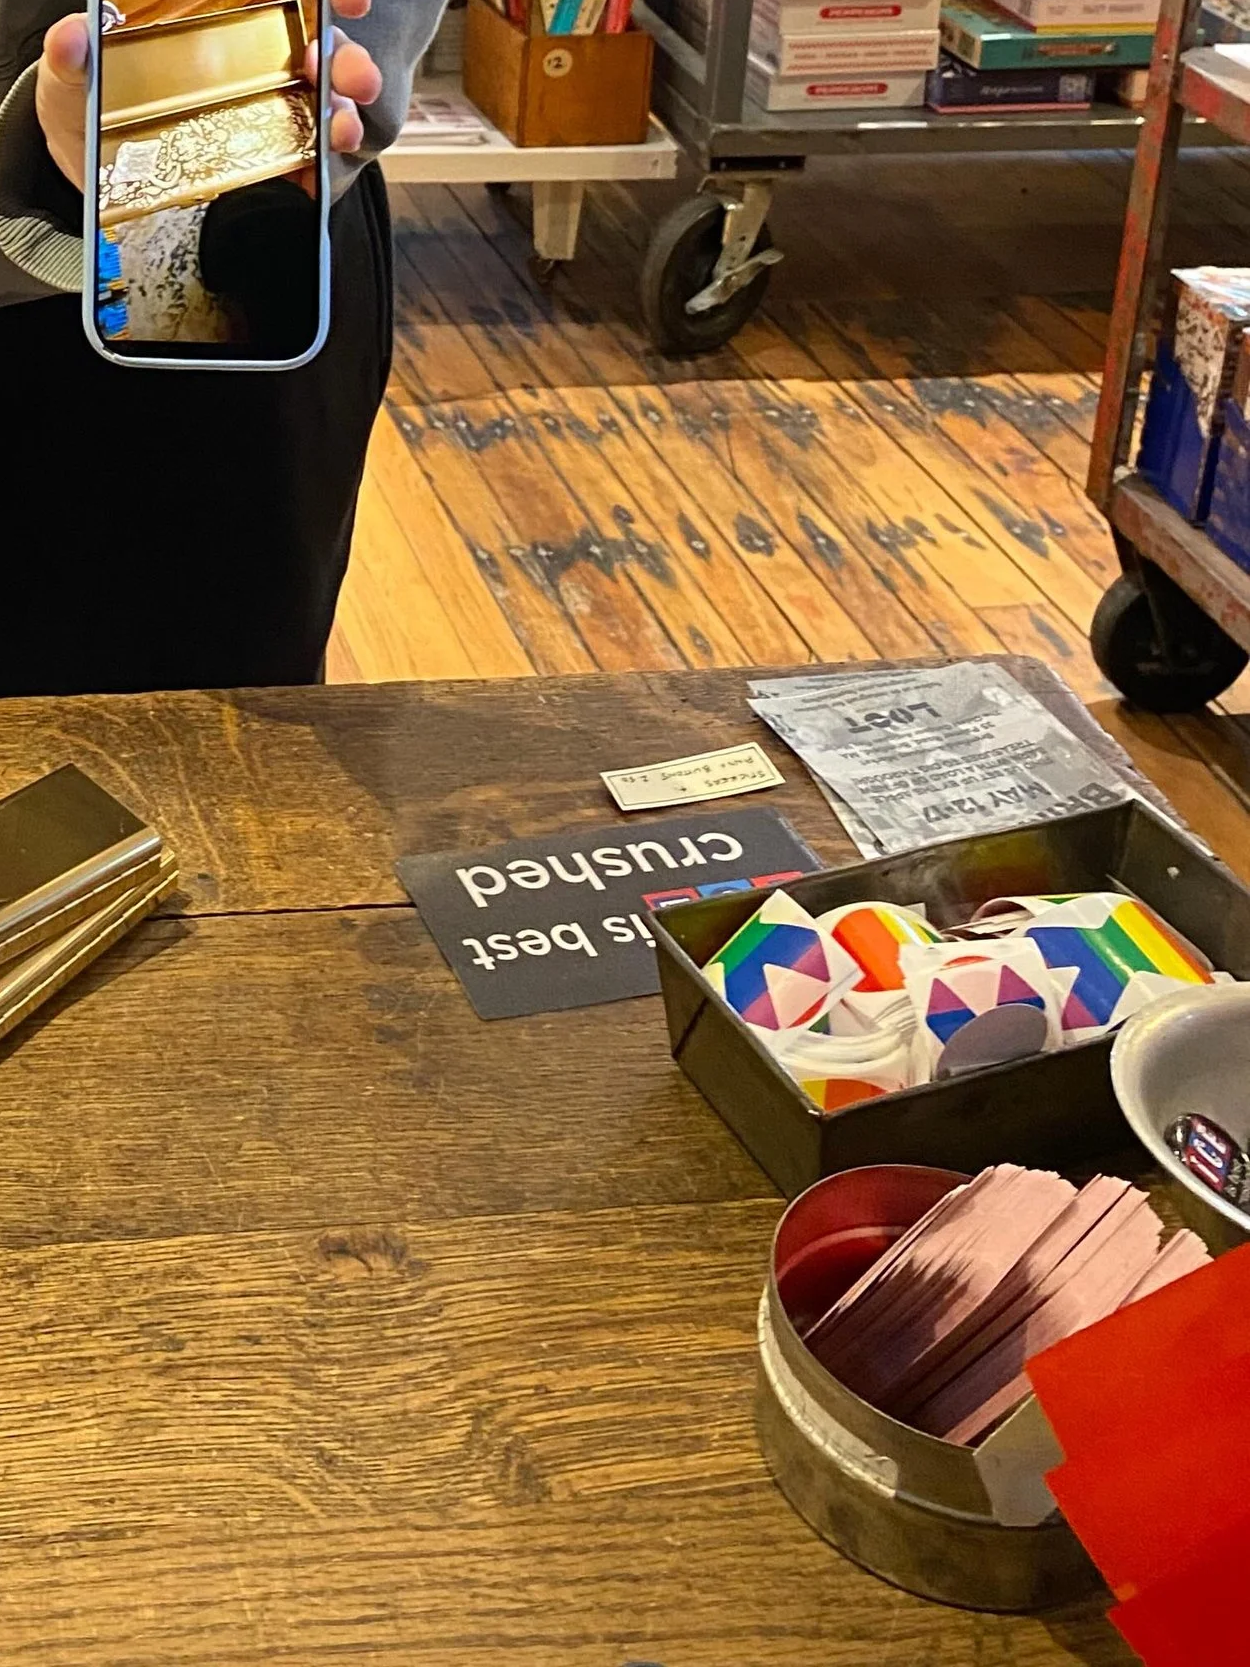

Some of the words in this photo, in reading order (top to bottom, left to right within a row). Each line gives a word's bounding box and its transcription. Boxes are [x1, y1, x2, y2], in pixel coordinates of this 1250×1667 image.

[705, 771, 766, 788] STICKERS
[980, 780, 1053, 808] MAY
[455, 832, 744, 908] crushed
[462, 921, 598, 971] best
[602, 914, 657, 948] is
